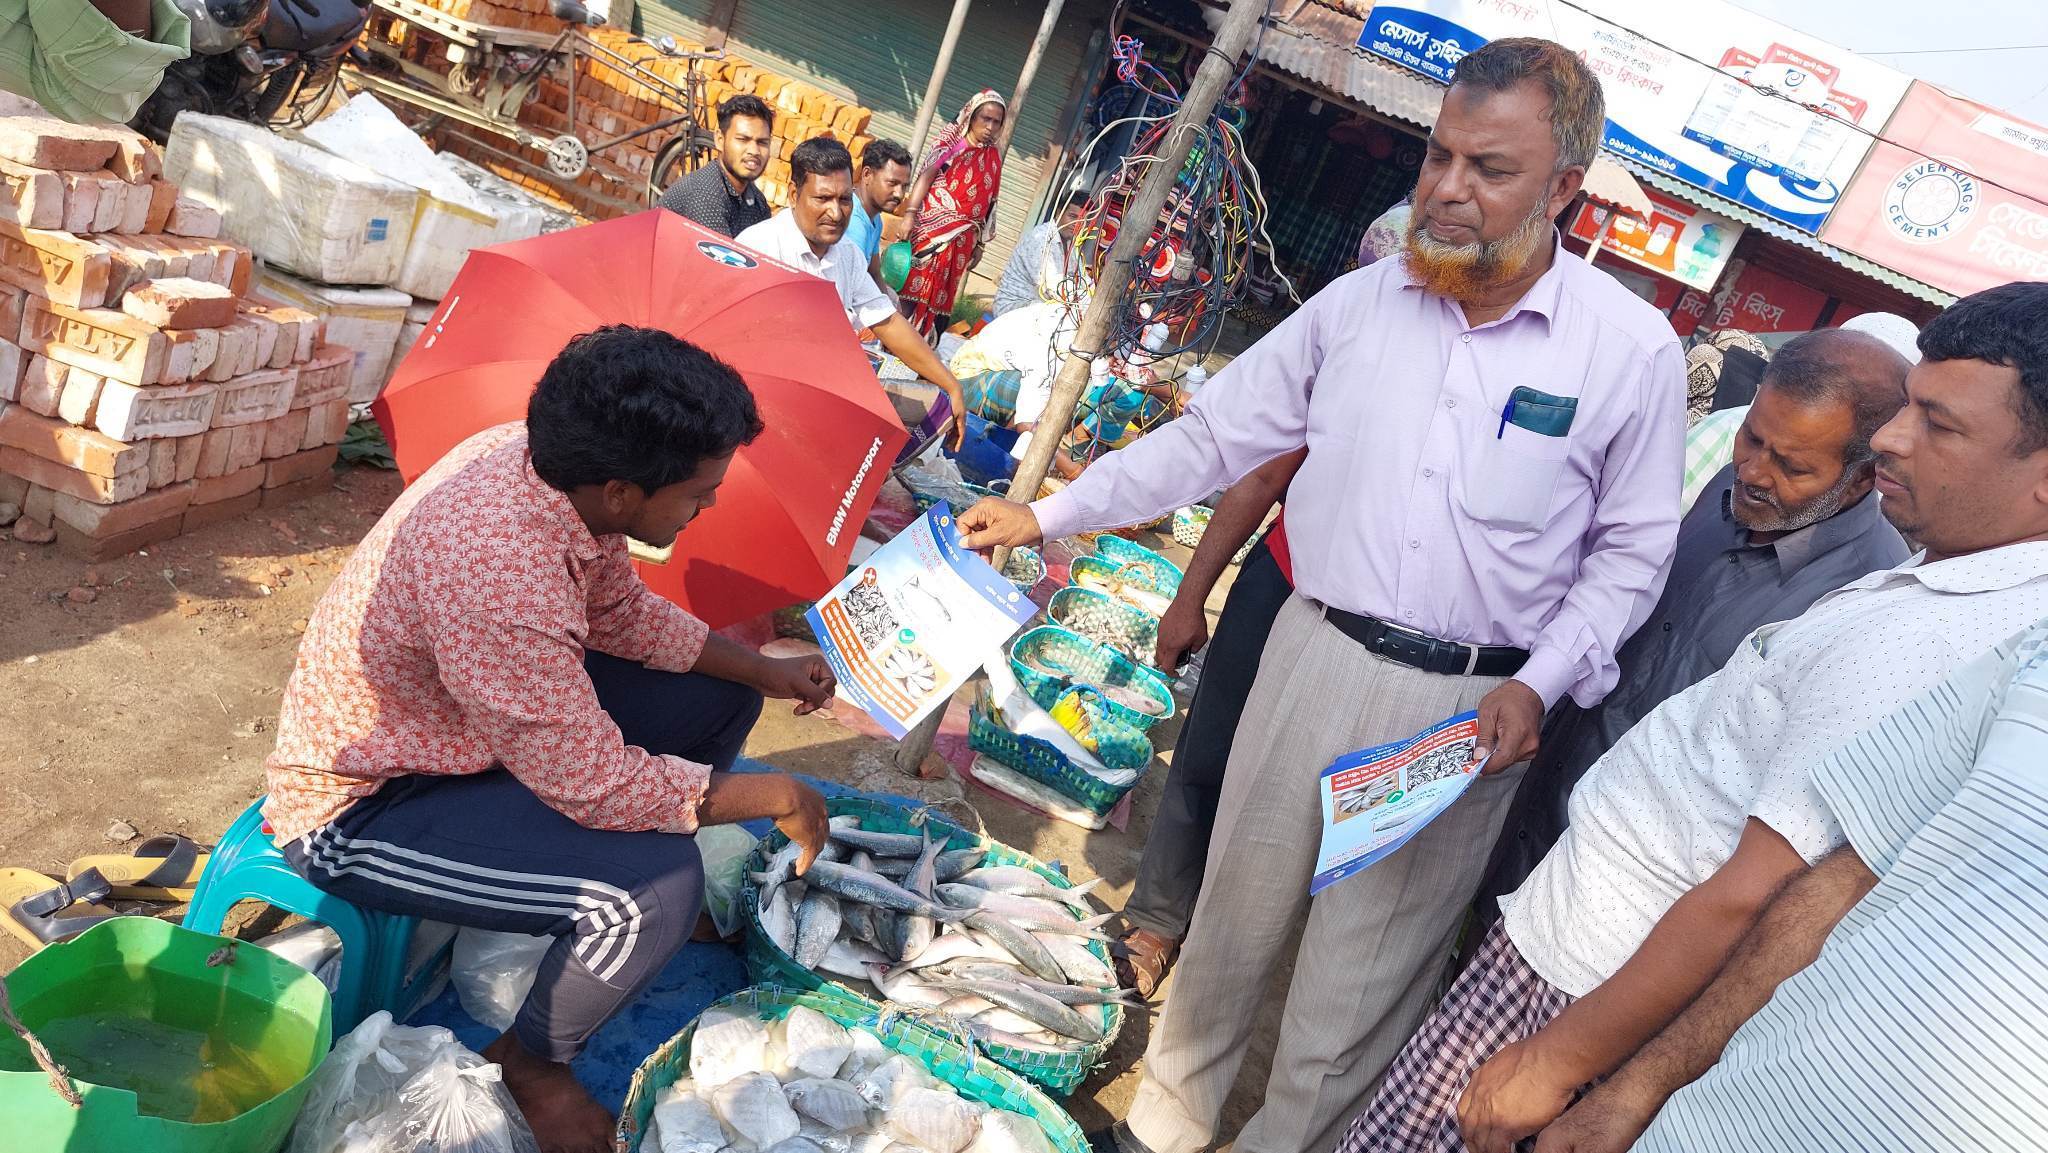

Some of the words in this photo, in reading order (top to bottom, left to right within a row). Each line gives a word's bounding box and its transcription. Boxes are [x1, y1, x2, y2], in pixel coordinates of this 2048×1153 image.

[1379, 19, 1430, 50] মেসার্স
[1424, 38, 1469, 65] তুহিন
[1896, 162, 1948, 191] SEVEN
[1889, 203, 1950, 239] CEMENT
[826, 505, 848, 547] BMW
[841, 436, 884, 508] Motorsport
